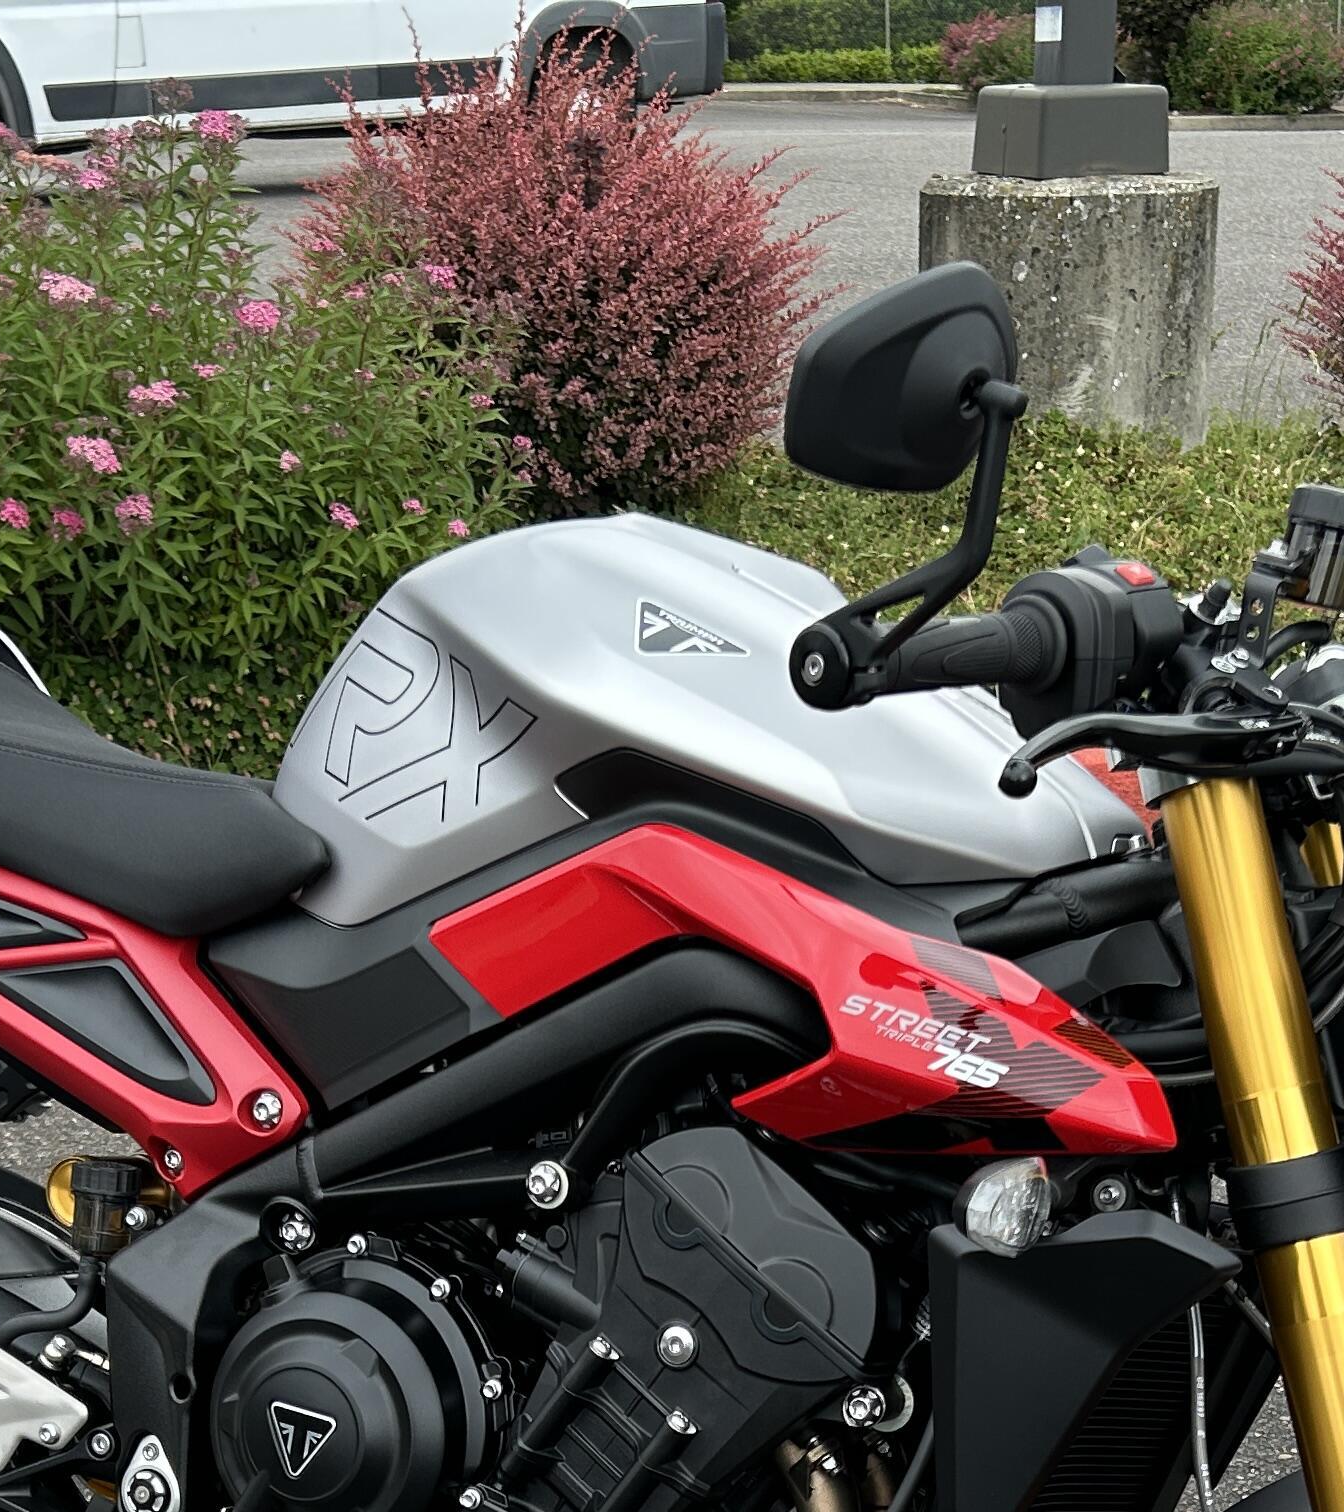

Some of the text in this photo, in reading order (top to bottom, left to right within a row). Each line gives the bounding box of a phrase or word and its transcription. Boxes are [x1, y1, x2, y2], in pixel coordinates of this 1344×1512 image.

[659, 609, 724, 646] TRIUMPH
[290, 607, 538, 822] RX
[839, 995, 992, 1052] STREET
[875, 1024, 1010, 1088] TRIPLE 765
